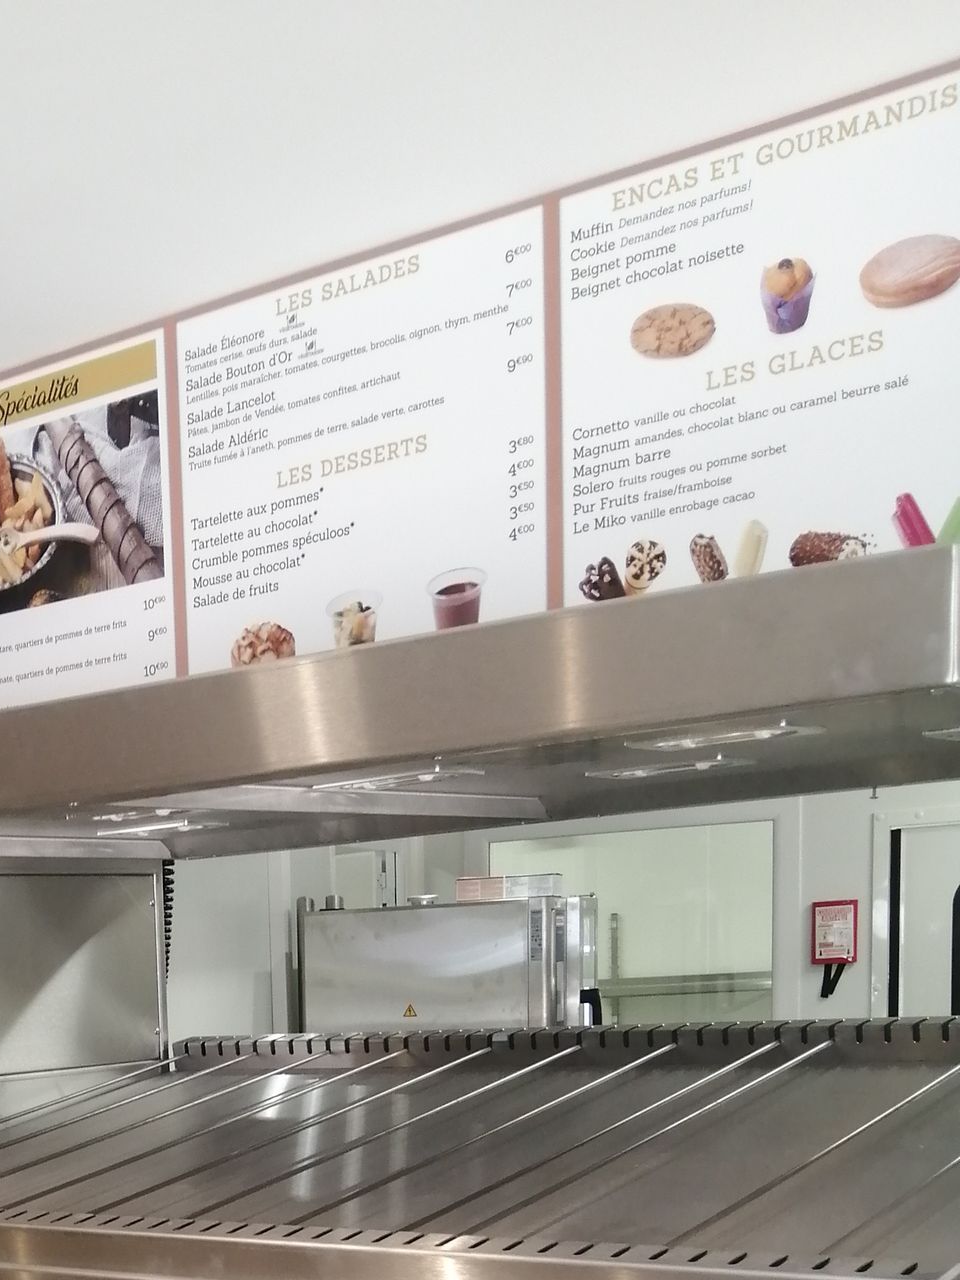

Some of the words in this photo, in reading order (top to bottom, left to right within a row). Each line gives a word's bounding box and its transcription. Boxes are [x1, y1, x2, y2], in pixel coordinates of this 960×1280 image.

[611, 166, 698, 212] ENCAS
[709, 151, 743, 181] ET
[755, 82, 958, 165] GOURMANDIS
[570, 222, 613, 243] Muffin
[618, 205, 674, 229] Demandez
[677, 198, 696, 211] nos
[699, 179, 751, 207] parfums!
[570, 240, 615, 261] Cookie
[620, 224, 676, 248] Demandez
[679, 217, 698, 230] nos
[701, 199, 753, 226] parfums!
[570, 257, 620, 281] Beignet
[625, 242, 676, 269] pomme
[570, 276, 621, 300] Beignet
[625, 259, 683, 284] chocolat
[688, 243, 744, 267] noisette
[275, 288, 312, 316] LES
[321, 254, 419, 301] SALADES
[184, 343, 217, 361] Salade
[220, 329, 264, 350] Éléonore
[184, 358, 217, 374] Tomates
[290, 327, 317, 342] salade
[221, 382, 238, 396] pois
[473, 304, 508, 321] menthe
[705, 360, 755, 391] LES
[767, 329, 883, 375] GLACES
[185, 371, 222, 391] Salade
[225, 360, 265, 380] Bouton
[186, 405, 223, 425] Salade
[226, 391, 275, 414] Lancelot
[210, 416, 240, 434] jambon
[242, 412, 252, 422] de
[287, 394, 320, 410] tomates
[360, 371, 400, 389] artichaut
[571, 420, 629, 441] Cornetto
[633, 410, 669, 426] vanille
[672, 408, 685, 418] ou
[688, 396, 735, 414] chocolat
[572, 438, 630, 460] Magnum
[687, 416, 733, 434] chocolat
[737, 408, 768, 422] blanc
[771, 404, 786, 415] ou
[789, 391, 836, 411] caramel
[841, 383, 880, 399] beurre
[884, 374, 908, 390] salé
[188, 459, 211, 471] Truite
[213, 450, 237, 464] fumée
[239, 447, 244, 457] à
[277, 431, 312, 450] pommes
[313, 427, 324, 437] de
[350, 412, 378, 427] salade
[407, 396, 444, 412] carottes
[188, 439, 224, 458] Salade
[228, 428, 268, 448] Aldéric
[276, 463, 312, 488] LES
[320, 433, 427, 478] DESSERTS
[572, 457, 630, 479] Magnum
[634, 448, 670, 464] barre
[572, 480, 614, 497] Solero
[618, 474, 647, 487] fruits
[650, 466, 686, 480] rouges
[688, 463, 702, 472] ou
[706, 453, 747, 471] pomme
[750, 444, 786, 459] sorbet
[190, 510, 243, 530] Tartelette
[246, 503, 266, 517] aux
[572, 502, 596, 516] Pur
[599, 493, 639, 510] Fruits
[643, 476, 732, 501] fraise/framboise
[573, 521, 589, 534] Le
[593, 514, 626, 530] Miko
[630, 507, 665, 522] vanille
[668, 498, 719, 515] enrobage
[722, 491, 755, 504] cacao
[191, 531, 243, 551] Tartelette
[247, 527, 261, 538] au
[191, 549, 238, 570] Crumble
[241, 540, 288, 562] pommes
[192, 572, 232, 589] Mousse
[235, 568, 249, 580] au
[193, 590, 229, 608] Salade
[232, 587, 245, 600] de
[248, 581, 278, 597] fruits
[14, 638, 43, 651] quartiers
[44, 634, 53, 644] de
[54, 629, 82, 643] pommes
[83, 626, 92, 635] de
[94, 624, 110, 633] terre
[112, 620, 126, 629] frits
[14, 669, 44, 683] quartiers
[45, 666, 53, 675] de
[55, 661, 83, 675] pommes
[83, 658, 93, 667] de
[94, 656, 111, 665] terre
[112, 652, 127, 661] frits
